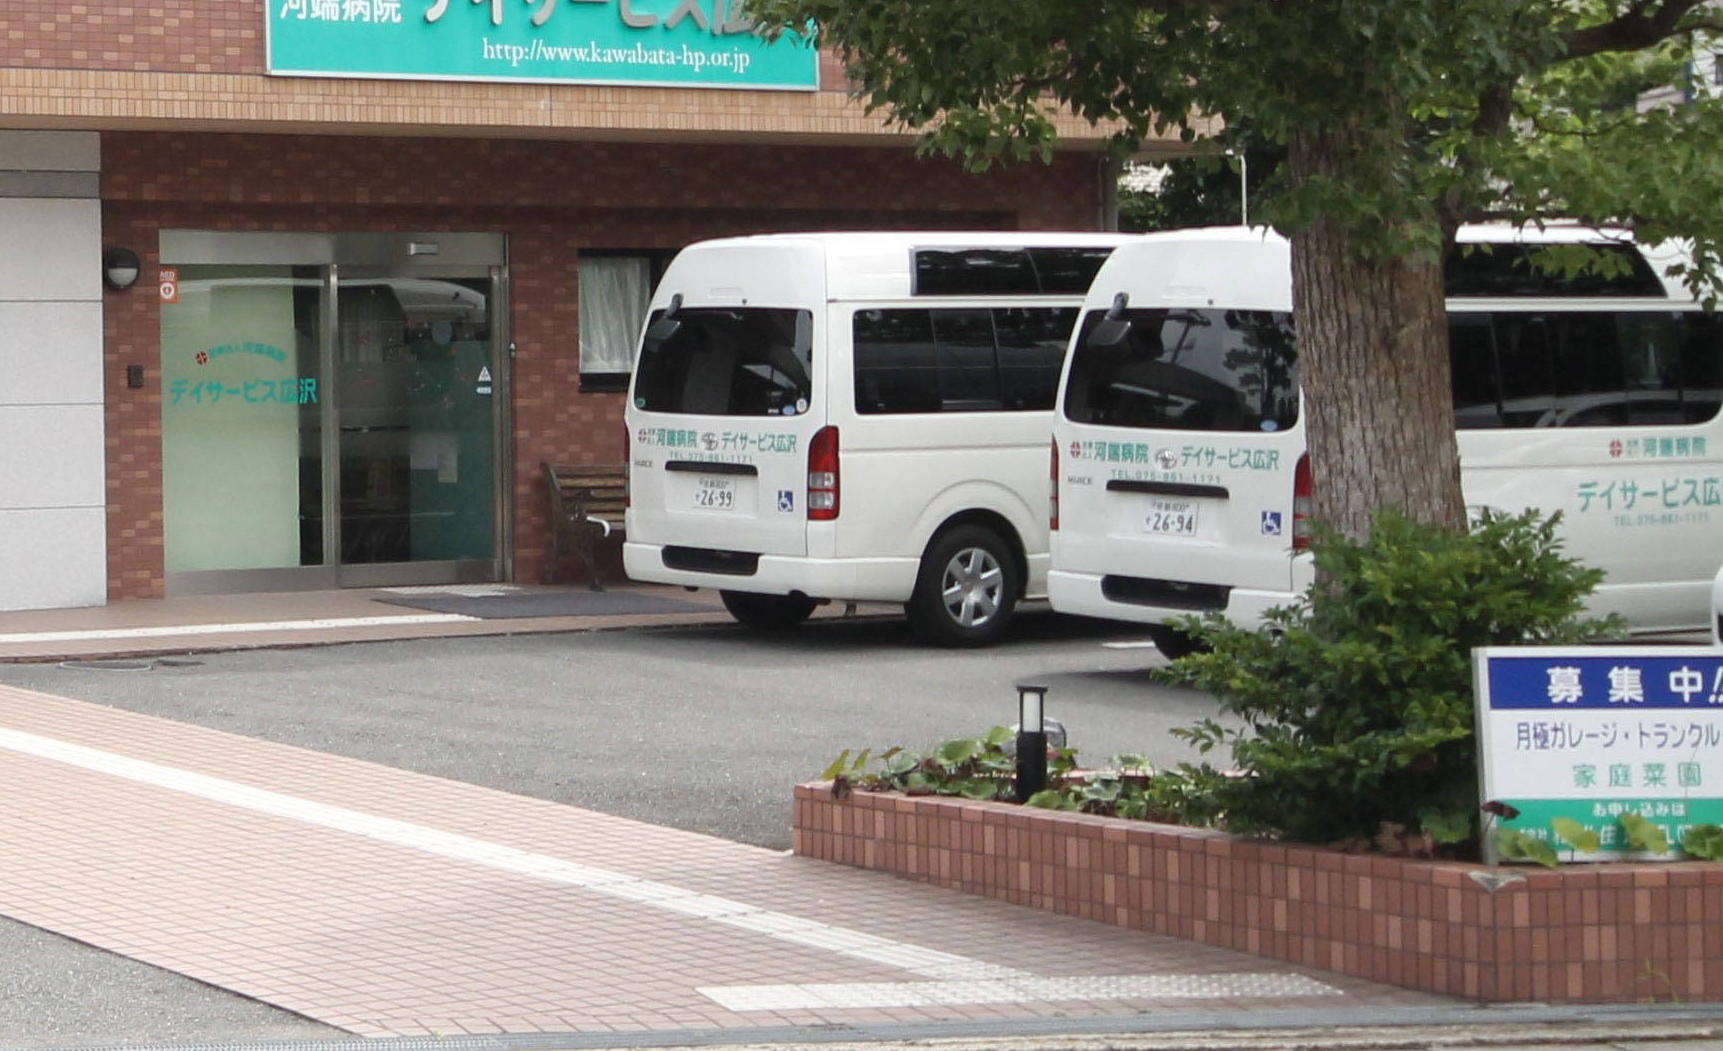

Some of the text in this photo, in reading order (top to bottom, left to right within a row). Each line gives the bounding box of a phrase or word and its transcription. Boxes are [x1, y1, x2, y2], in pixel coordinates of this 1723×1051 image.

[482, 37, 750, 74] http://www.kawabata-hp.or.jp
[170, 378, 318, 405] デイサービス広沢
[721, 432, 797, 452] デイサービス広沢
[1093, 441, 1149, 463] 河端病院
[1181, 445, 1280, 470] デイサービス広沢
[1578, 477, 1723, 512] デイサービス広
[1516, 721, 1723, 750] 月極ガレージ・トランクル
[1573, 762, 1702, 788] 家庭菜園
[1592, 801, 1687, 817] お申し込みは
